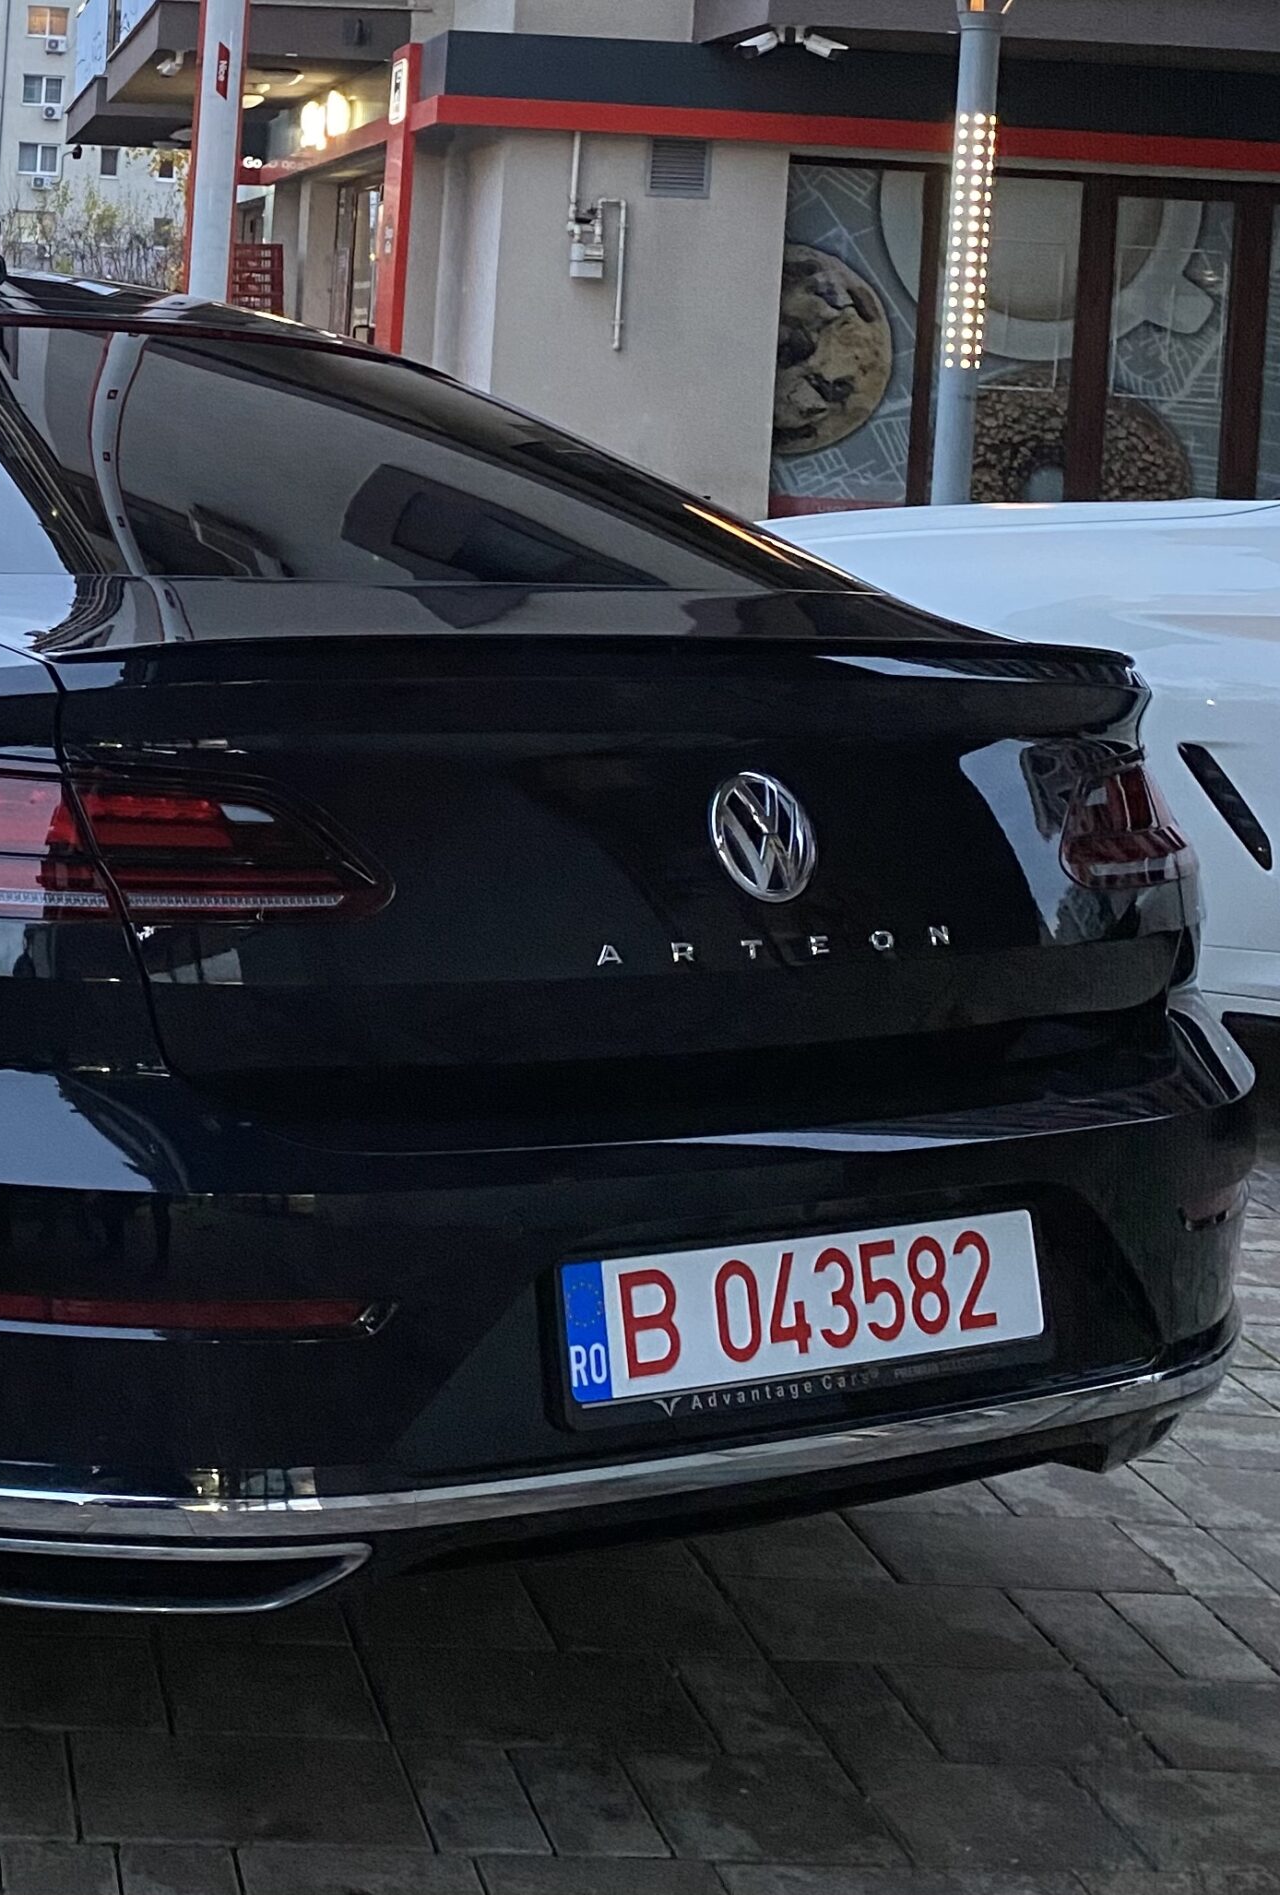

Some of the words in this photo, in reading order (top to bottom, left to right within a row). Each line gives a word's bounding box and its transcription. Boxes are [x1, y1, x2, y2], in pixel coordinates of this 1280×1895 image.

[596, 924, 951, 966] ARTEON
[618, 1268, 681, 1380] B
[714, 1230, 998, 1363] 043582
[570, 1342, 608, 1387] RO
[691, 1380, 813, 1410] Advantage
